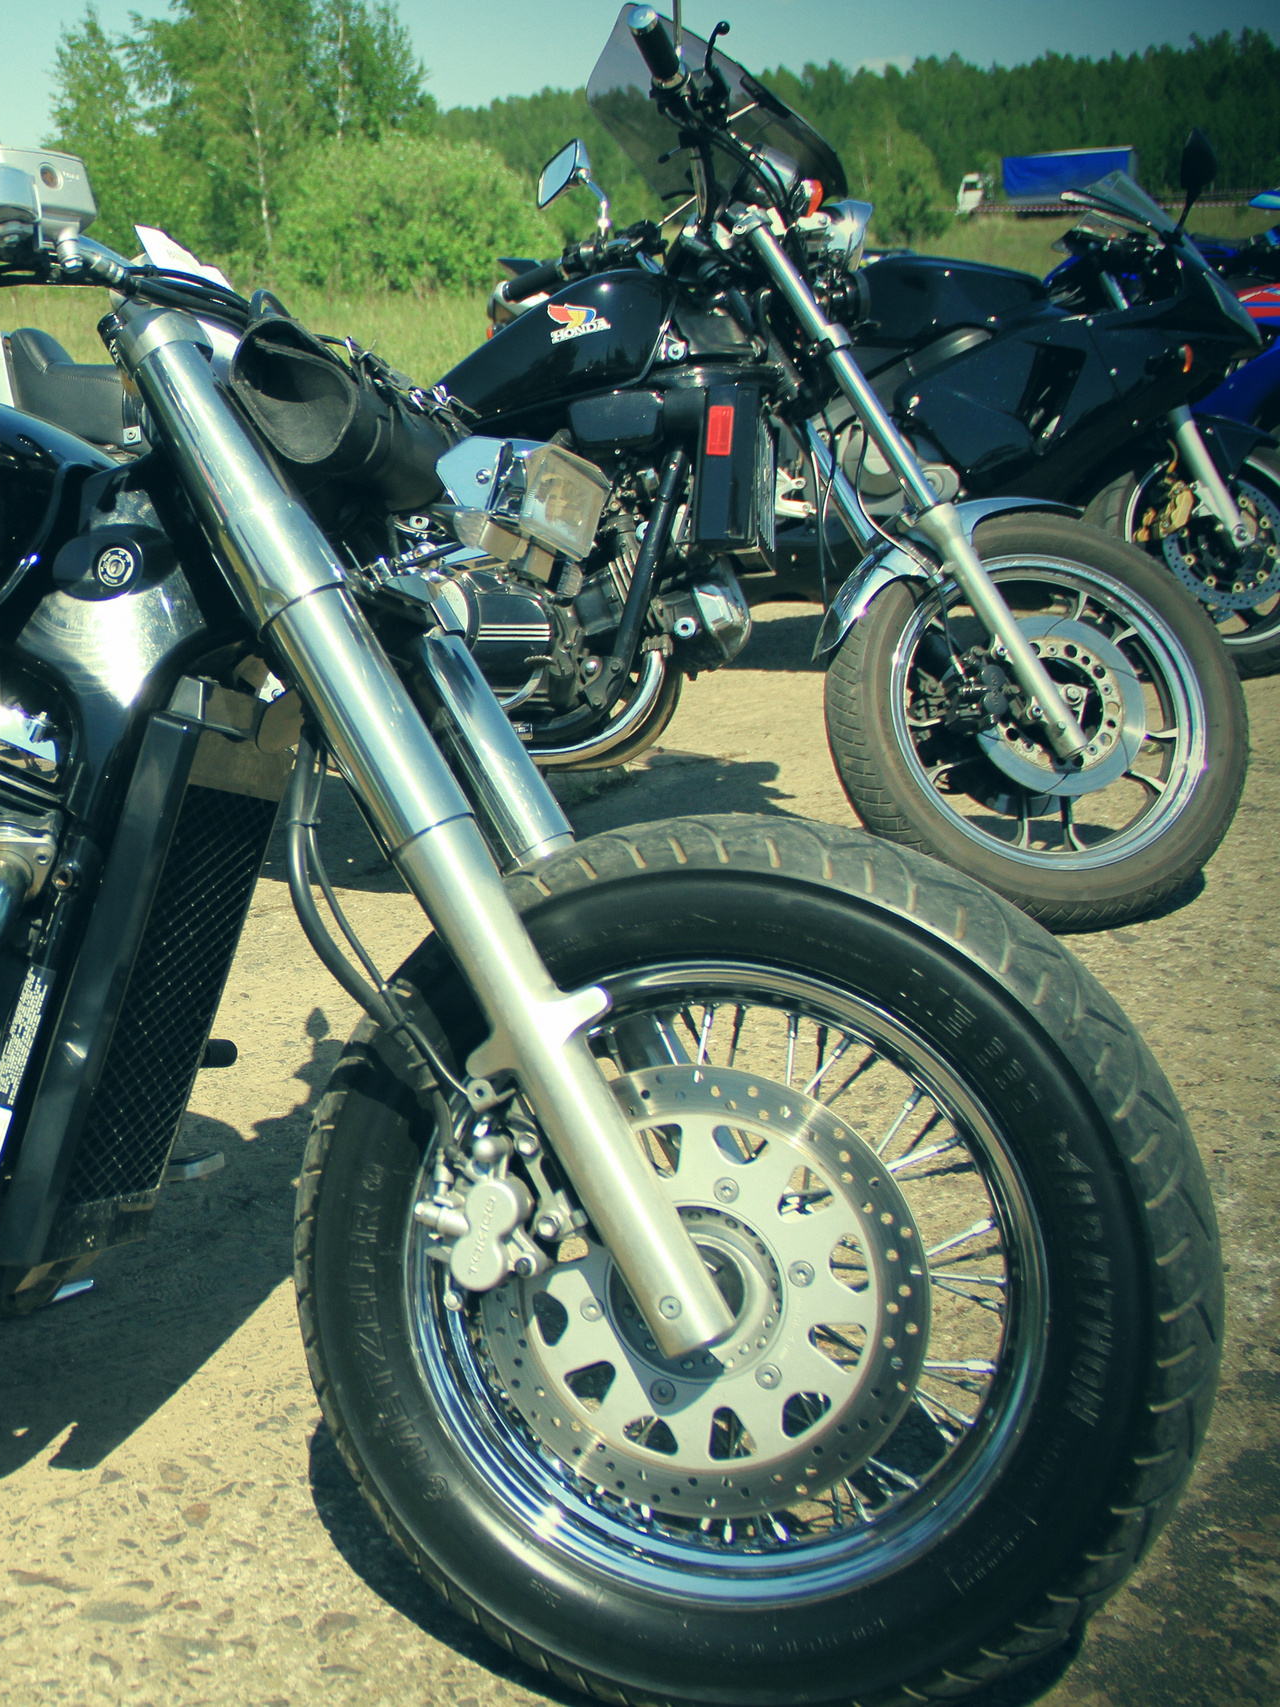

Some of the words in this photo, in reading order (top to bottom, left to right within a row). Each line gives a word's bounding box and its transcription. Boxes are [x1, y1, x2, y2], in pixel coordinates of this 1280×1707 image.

[551, 318, 610, 343] HONDA
[468, 1195, 497, 1275] TOKICO
[1040, 1129, 1113, 1427] MARATHON
[349, 1203, 430, 1466] METZELER
